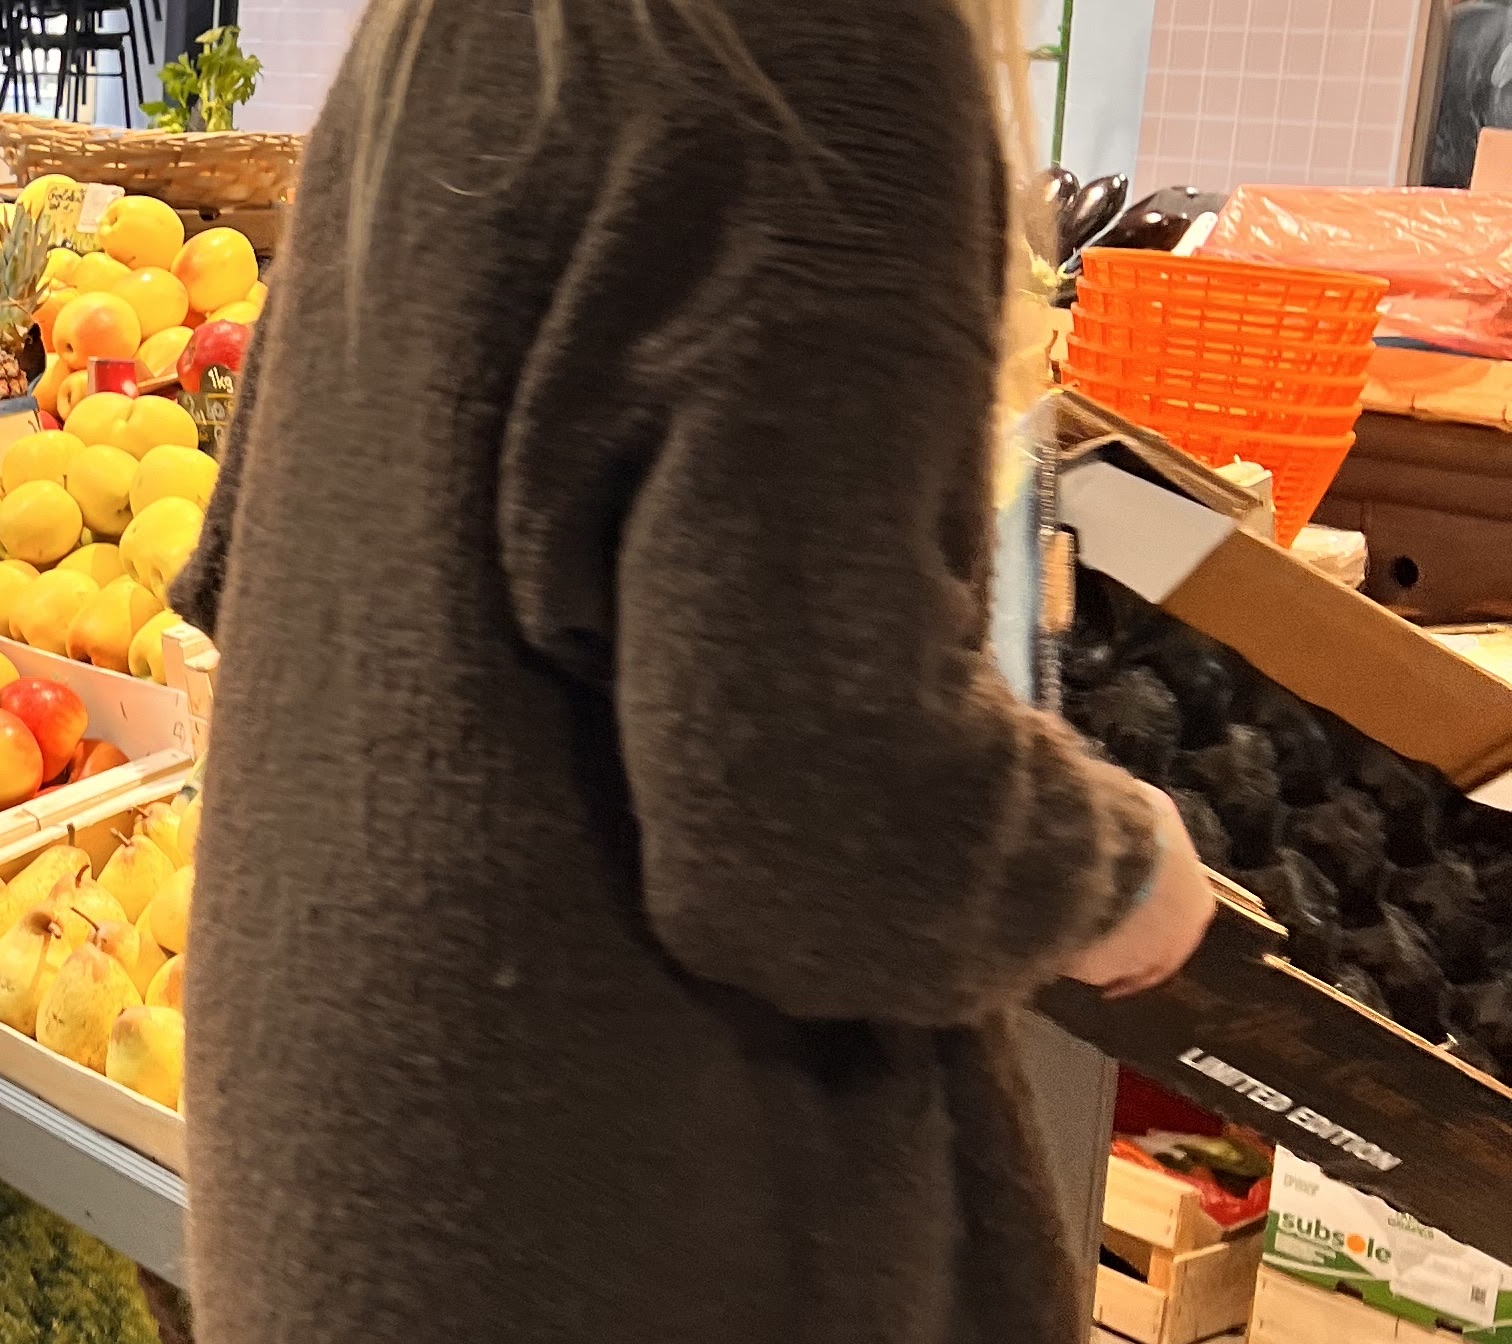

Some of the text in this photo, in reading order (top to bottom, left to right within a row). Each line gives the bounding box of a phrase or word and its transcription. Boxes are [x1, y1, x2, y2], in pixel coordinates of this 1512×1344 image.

[207, 365, 235, 395] 1kg
[1176, 1046, 1404, 1173] LIMITED EDITION
